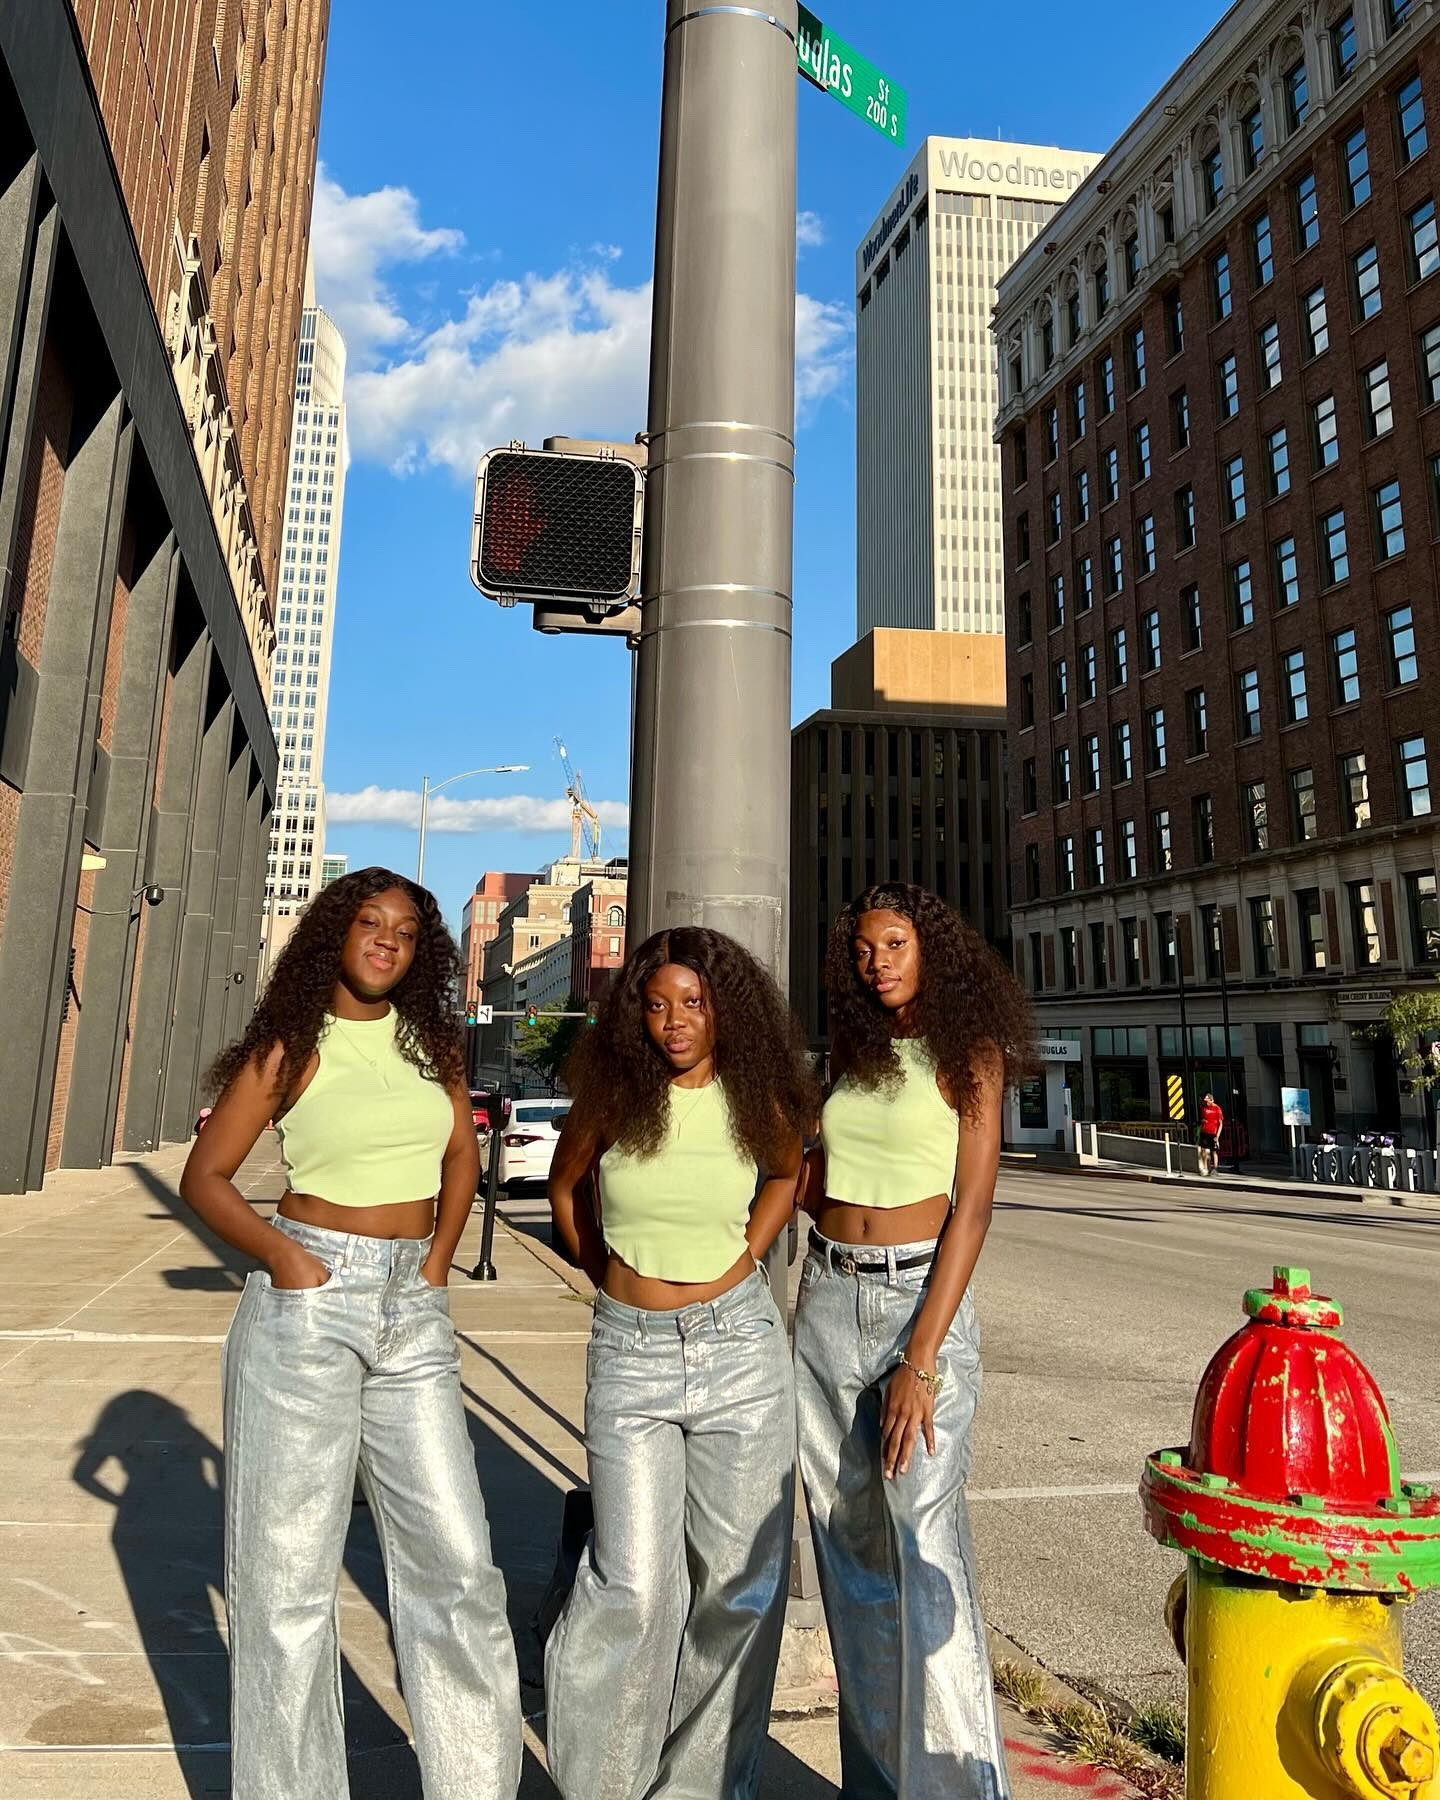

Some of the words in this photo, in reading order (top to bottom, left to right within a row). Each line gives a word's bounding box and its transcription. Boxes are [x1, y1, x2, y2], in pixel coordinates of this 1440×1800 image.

[794, 26, 853, 97] uglas
[879, 79, 889, 105] St
[867, 95, 887, 128] 200
[891, 114, 898, 136] S
[1039, 1046, 1067, 1055] OUGLAS
